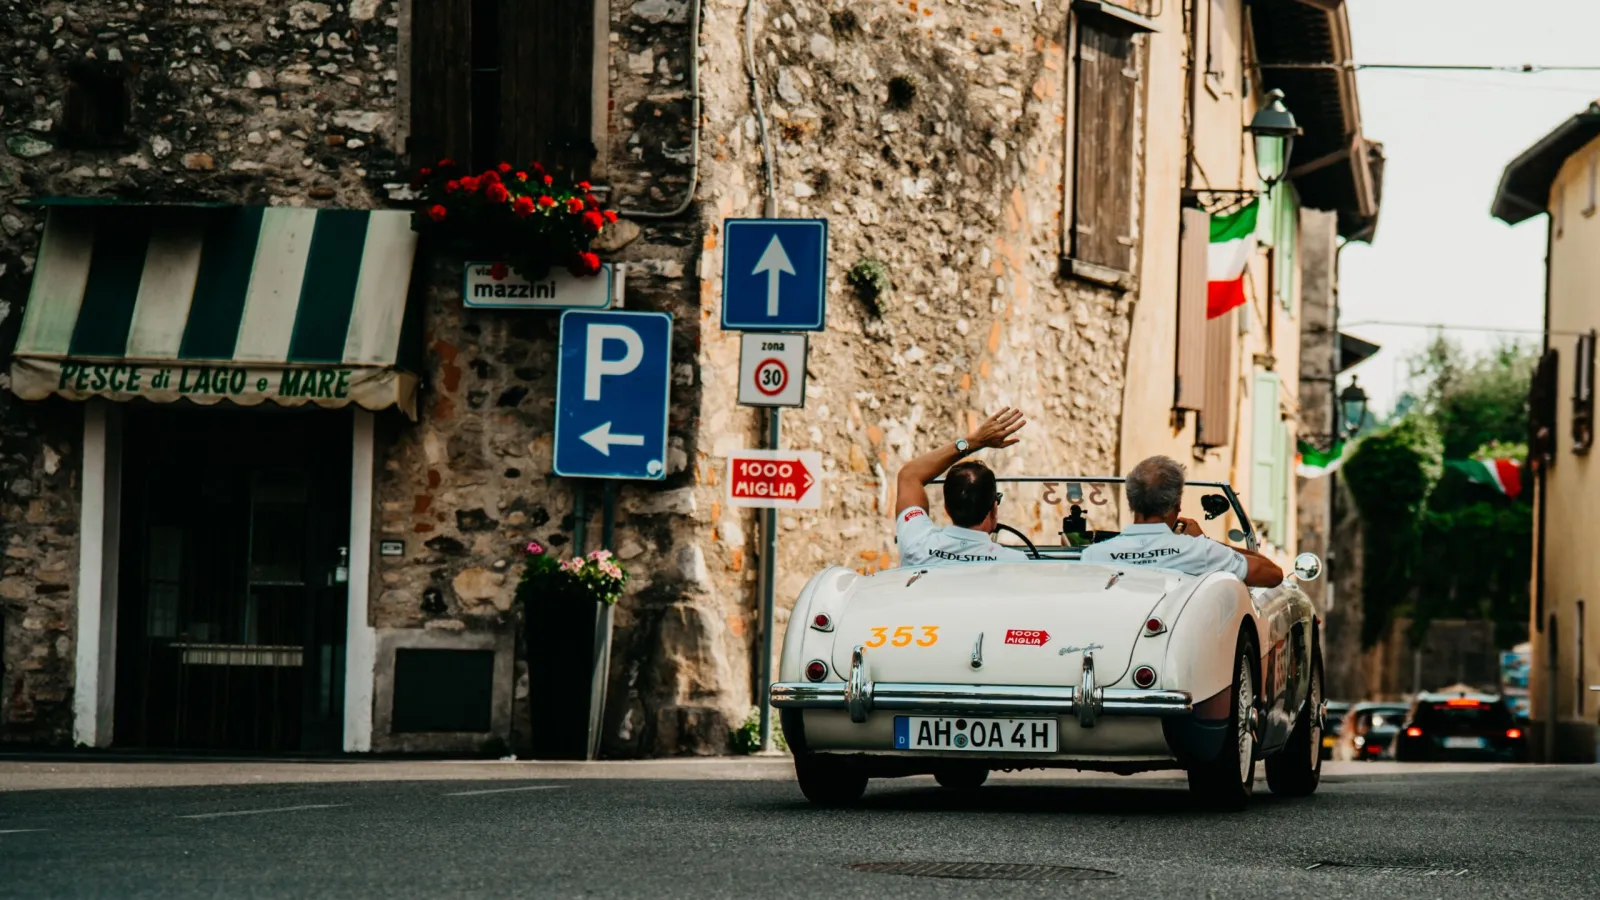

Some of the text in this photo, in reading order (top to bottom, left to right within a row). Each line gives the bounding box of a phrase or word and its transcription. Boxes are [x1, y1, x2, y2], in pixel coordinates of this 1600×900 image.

[474, 281, 556, 299] mazzini
[761, 340, 785, 352] zona
[584, 323, 644, 401] P
[59, 363, 353, 398] PESCE di LAGO e MARE
[762, 369, 781, 387] 30
[739, 462, 793, 478] 1000
[735, 481, 796, 497] MIGLIA
[1110, 548, 1180, 560] VREDESTEIN
[866, 625, 940, 648] 353
[1006, 637, 1040, 645] MIGLIA
[899, 736, 905, 744] D
